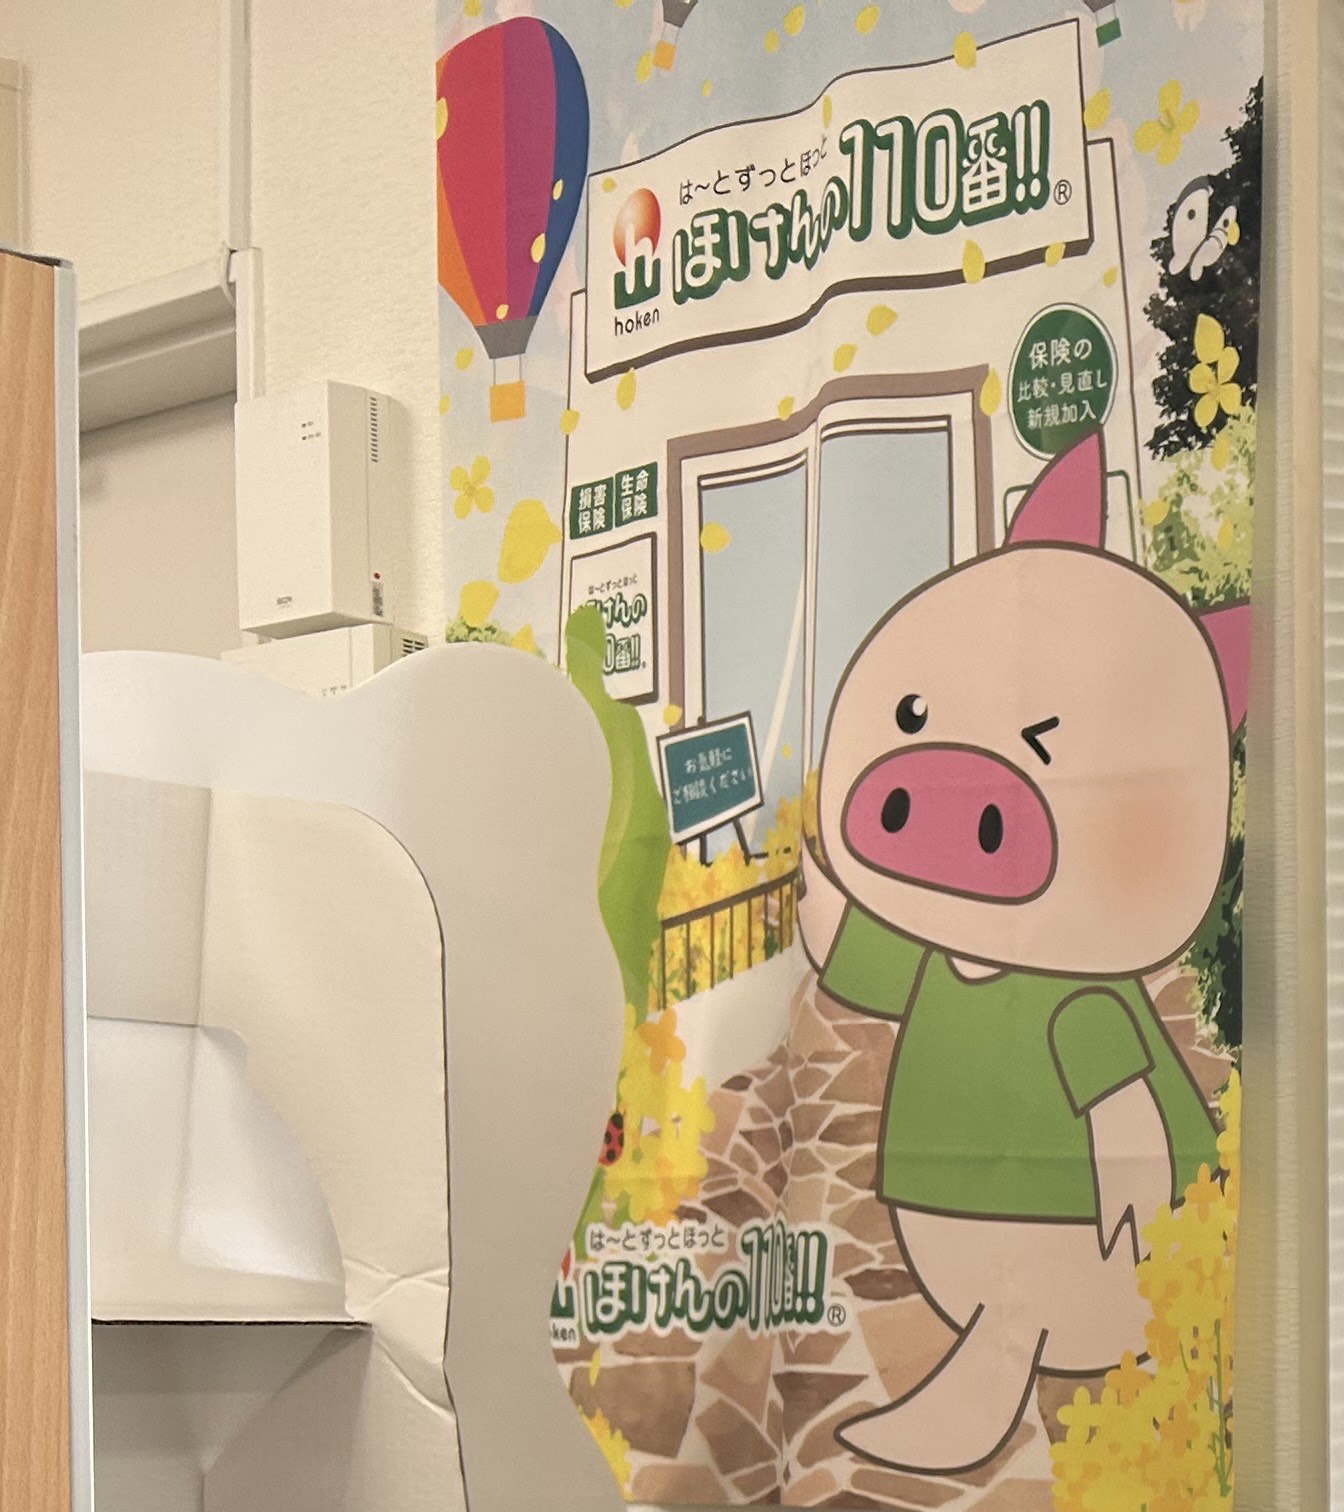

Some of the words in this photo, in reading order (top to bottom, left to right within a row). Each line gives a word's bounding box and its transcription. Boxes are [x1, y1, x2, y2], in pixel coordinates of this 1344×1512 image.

[613, 307, 660, 337] hoken
[1029, 337, 1093, 370] 保険の
[1027, 399, 1097, 429] 新規加入
[578, 483, 607, 511] 損害
[578, 507, 606, 535] 保険
[584, 592, 648, 629] けんの
[550, 1323, 577, 1341] ken
